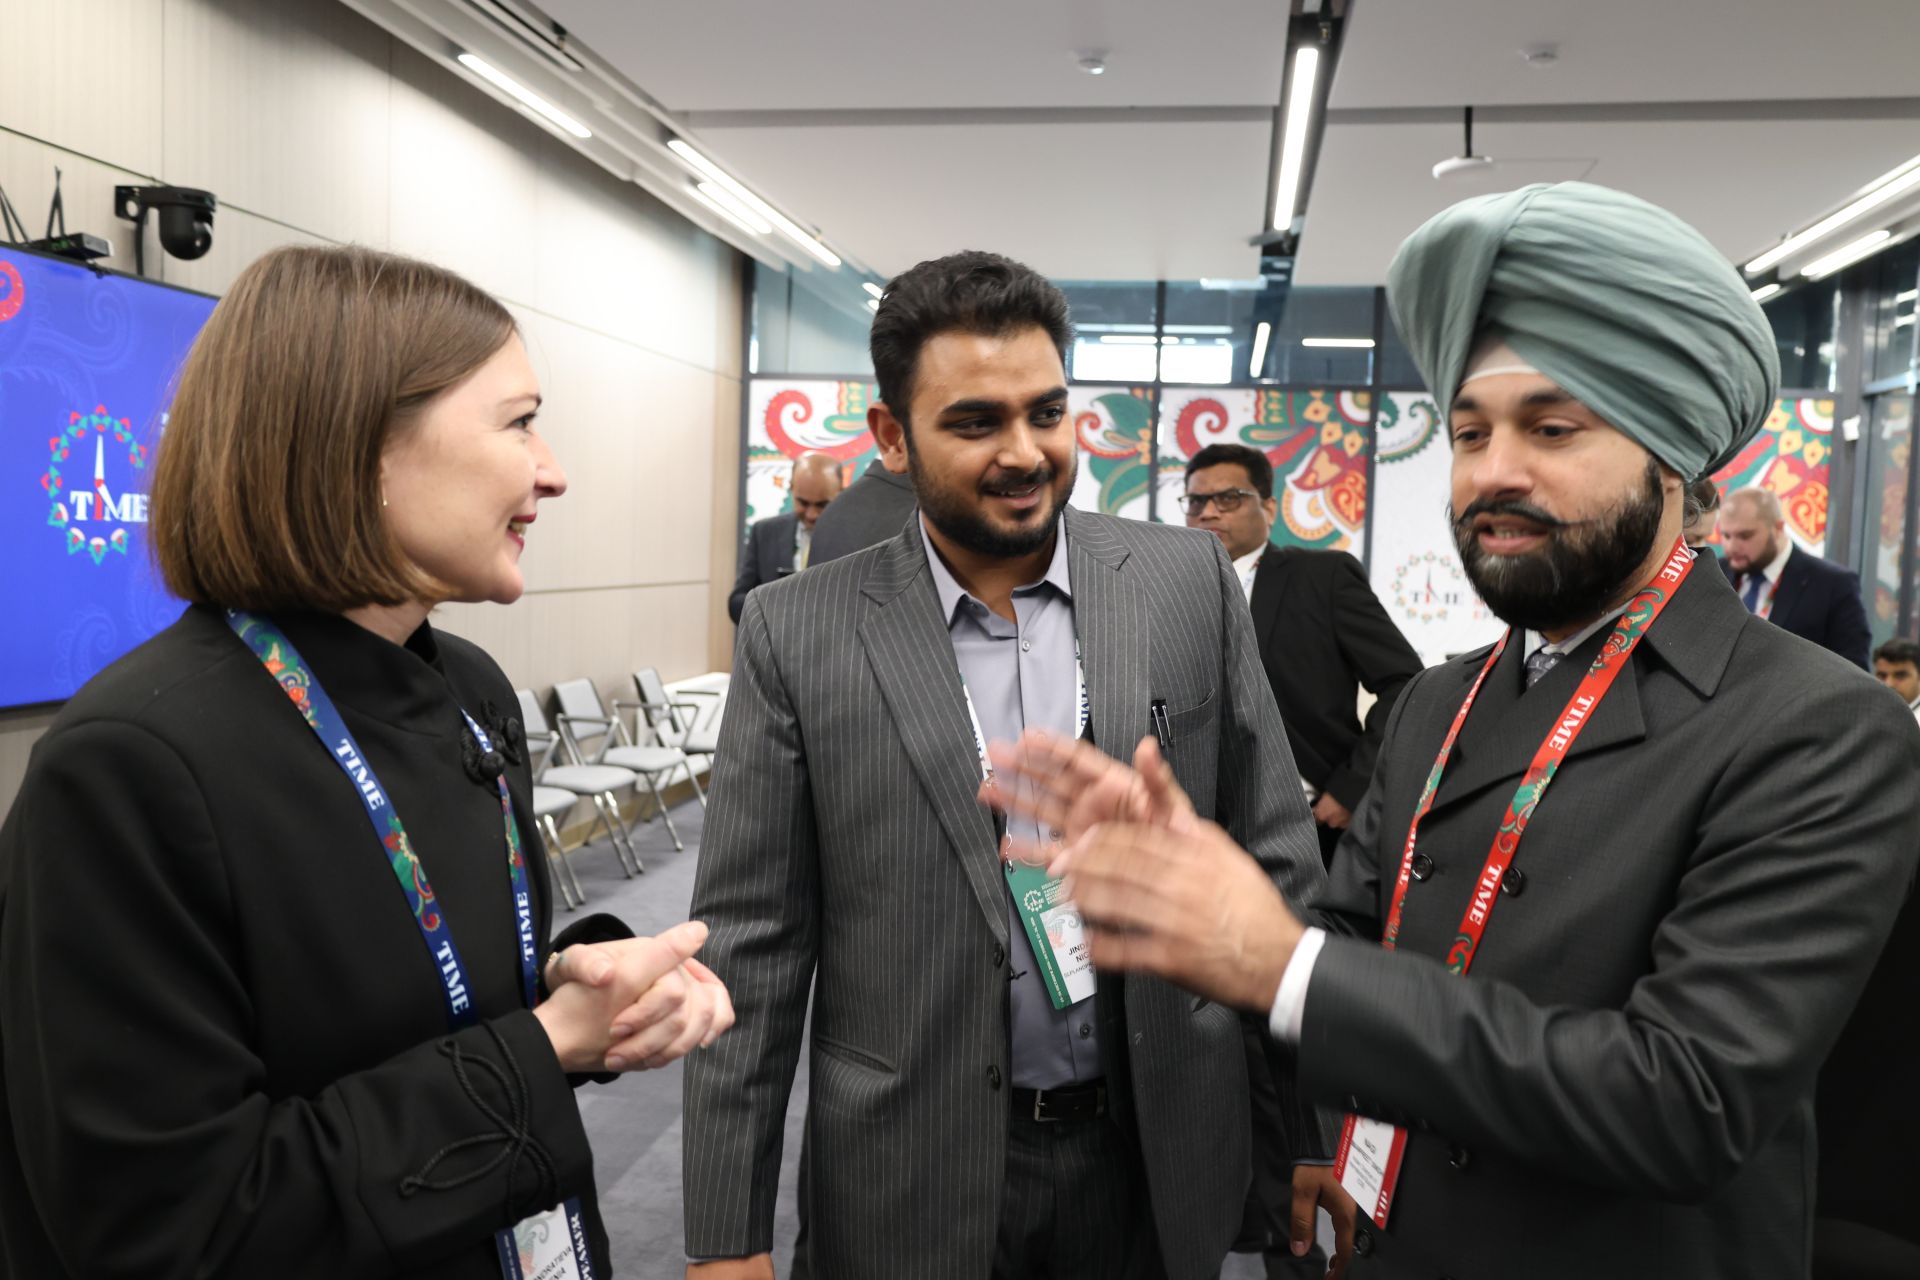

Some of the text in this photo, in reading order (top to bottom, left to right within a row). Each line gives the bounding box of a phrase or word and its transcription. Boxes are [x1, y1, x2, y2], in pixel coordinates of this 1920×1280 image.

[69, 490, 149, 523] TIME
[1548, 695, 1595, 752] TIME
[335, 738, 385, 810] TIME
[517, 891, 534, 961] TIME
[1469, 863, 1503, 926] TIME
[436, 940, 469, 1015] TIME
